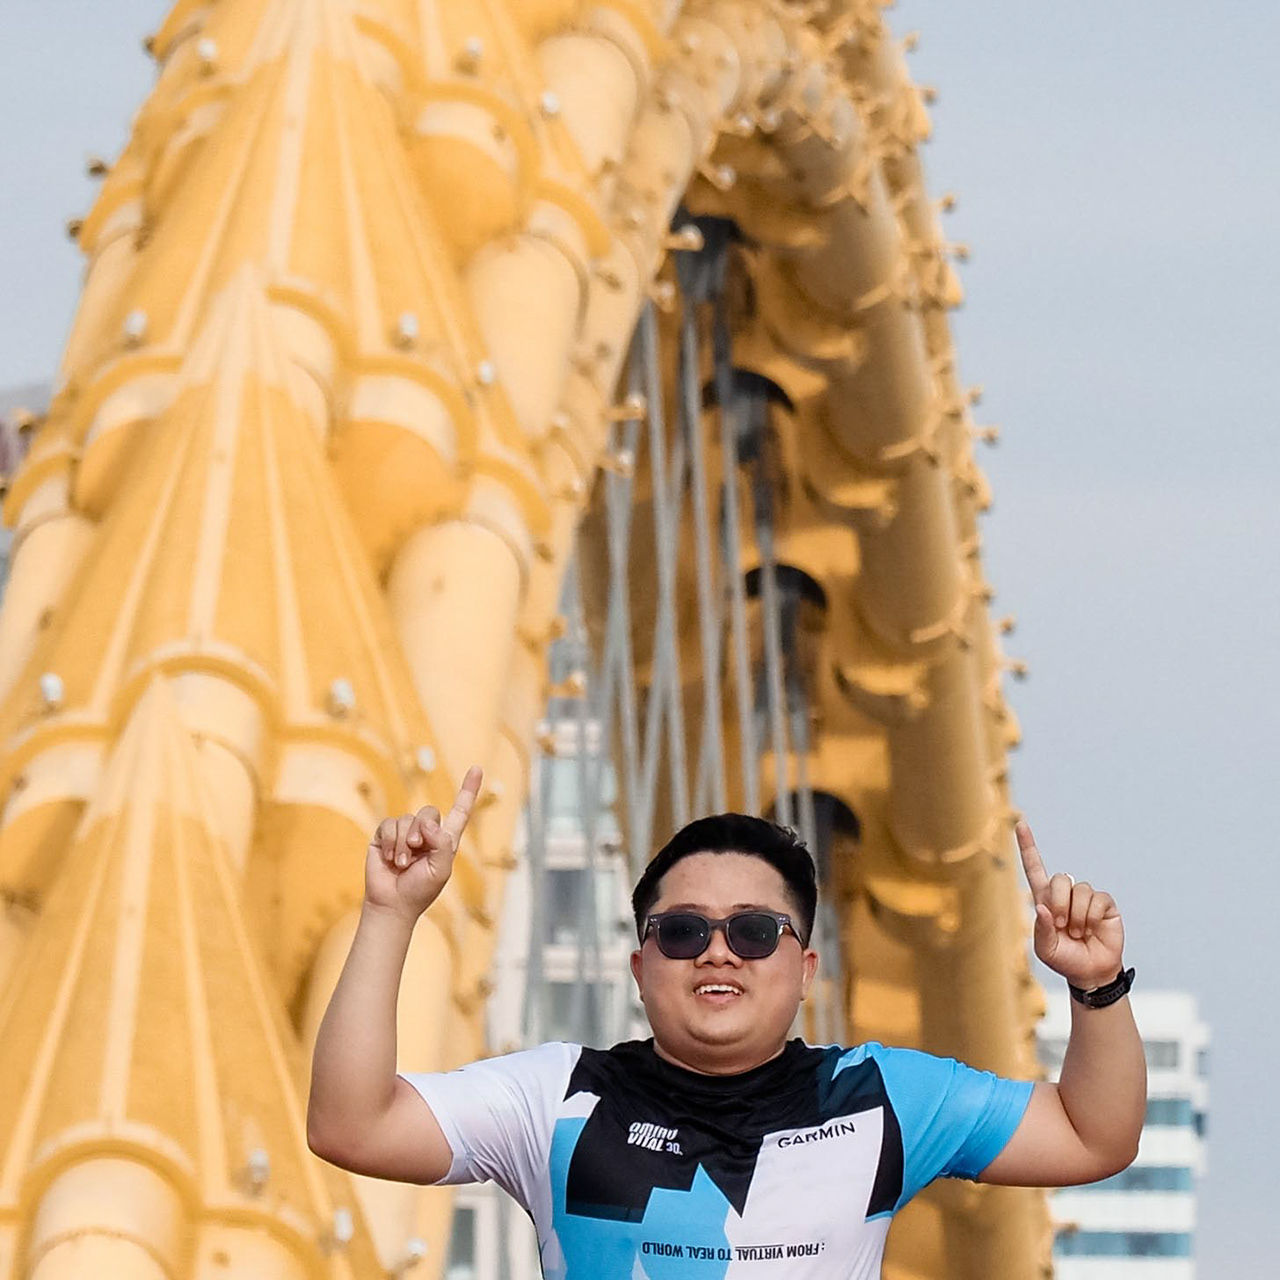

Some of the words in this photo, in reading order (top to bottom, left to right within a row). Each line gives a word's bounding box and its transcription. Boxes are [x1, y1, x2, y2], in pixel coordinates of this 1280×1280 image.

[627, 1132, 664, 1152] VITAL
[777, 1122, 856, 1149] GARMIN
[642, 1241, 684, 1258] WORLD
[685, 1245, 713, 1261] REAL
[717, 1247, 733, 1261] TO
[735, 1244, 785, 1261] VIRTUAL
